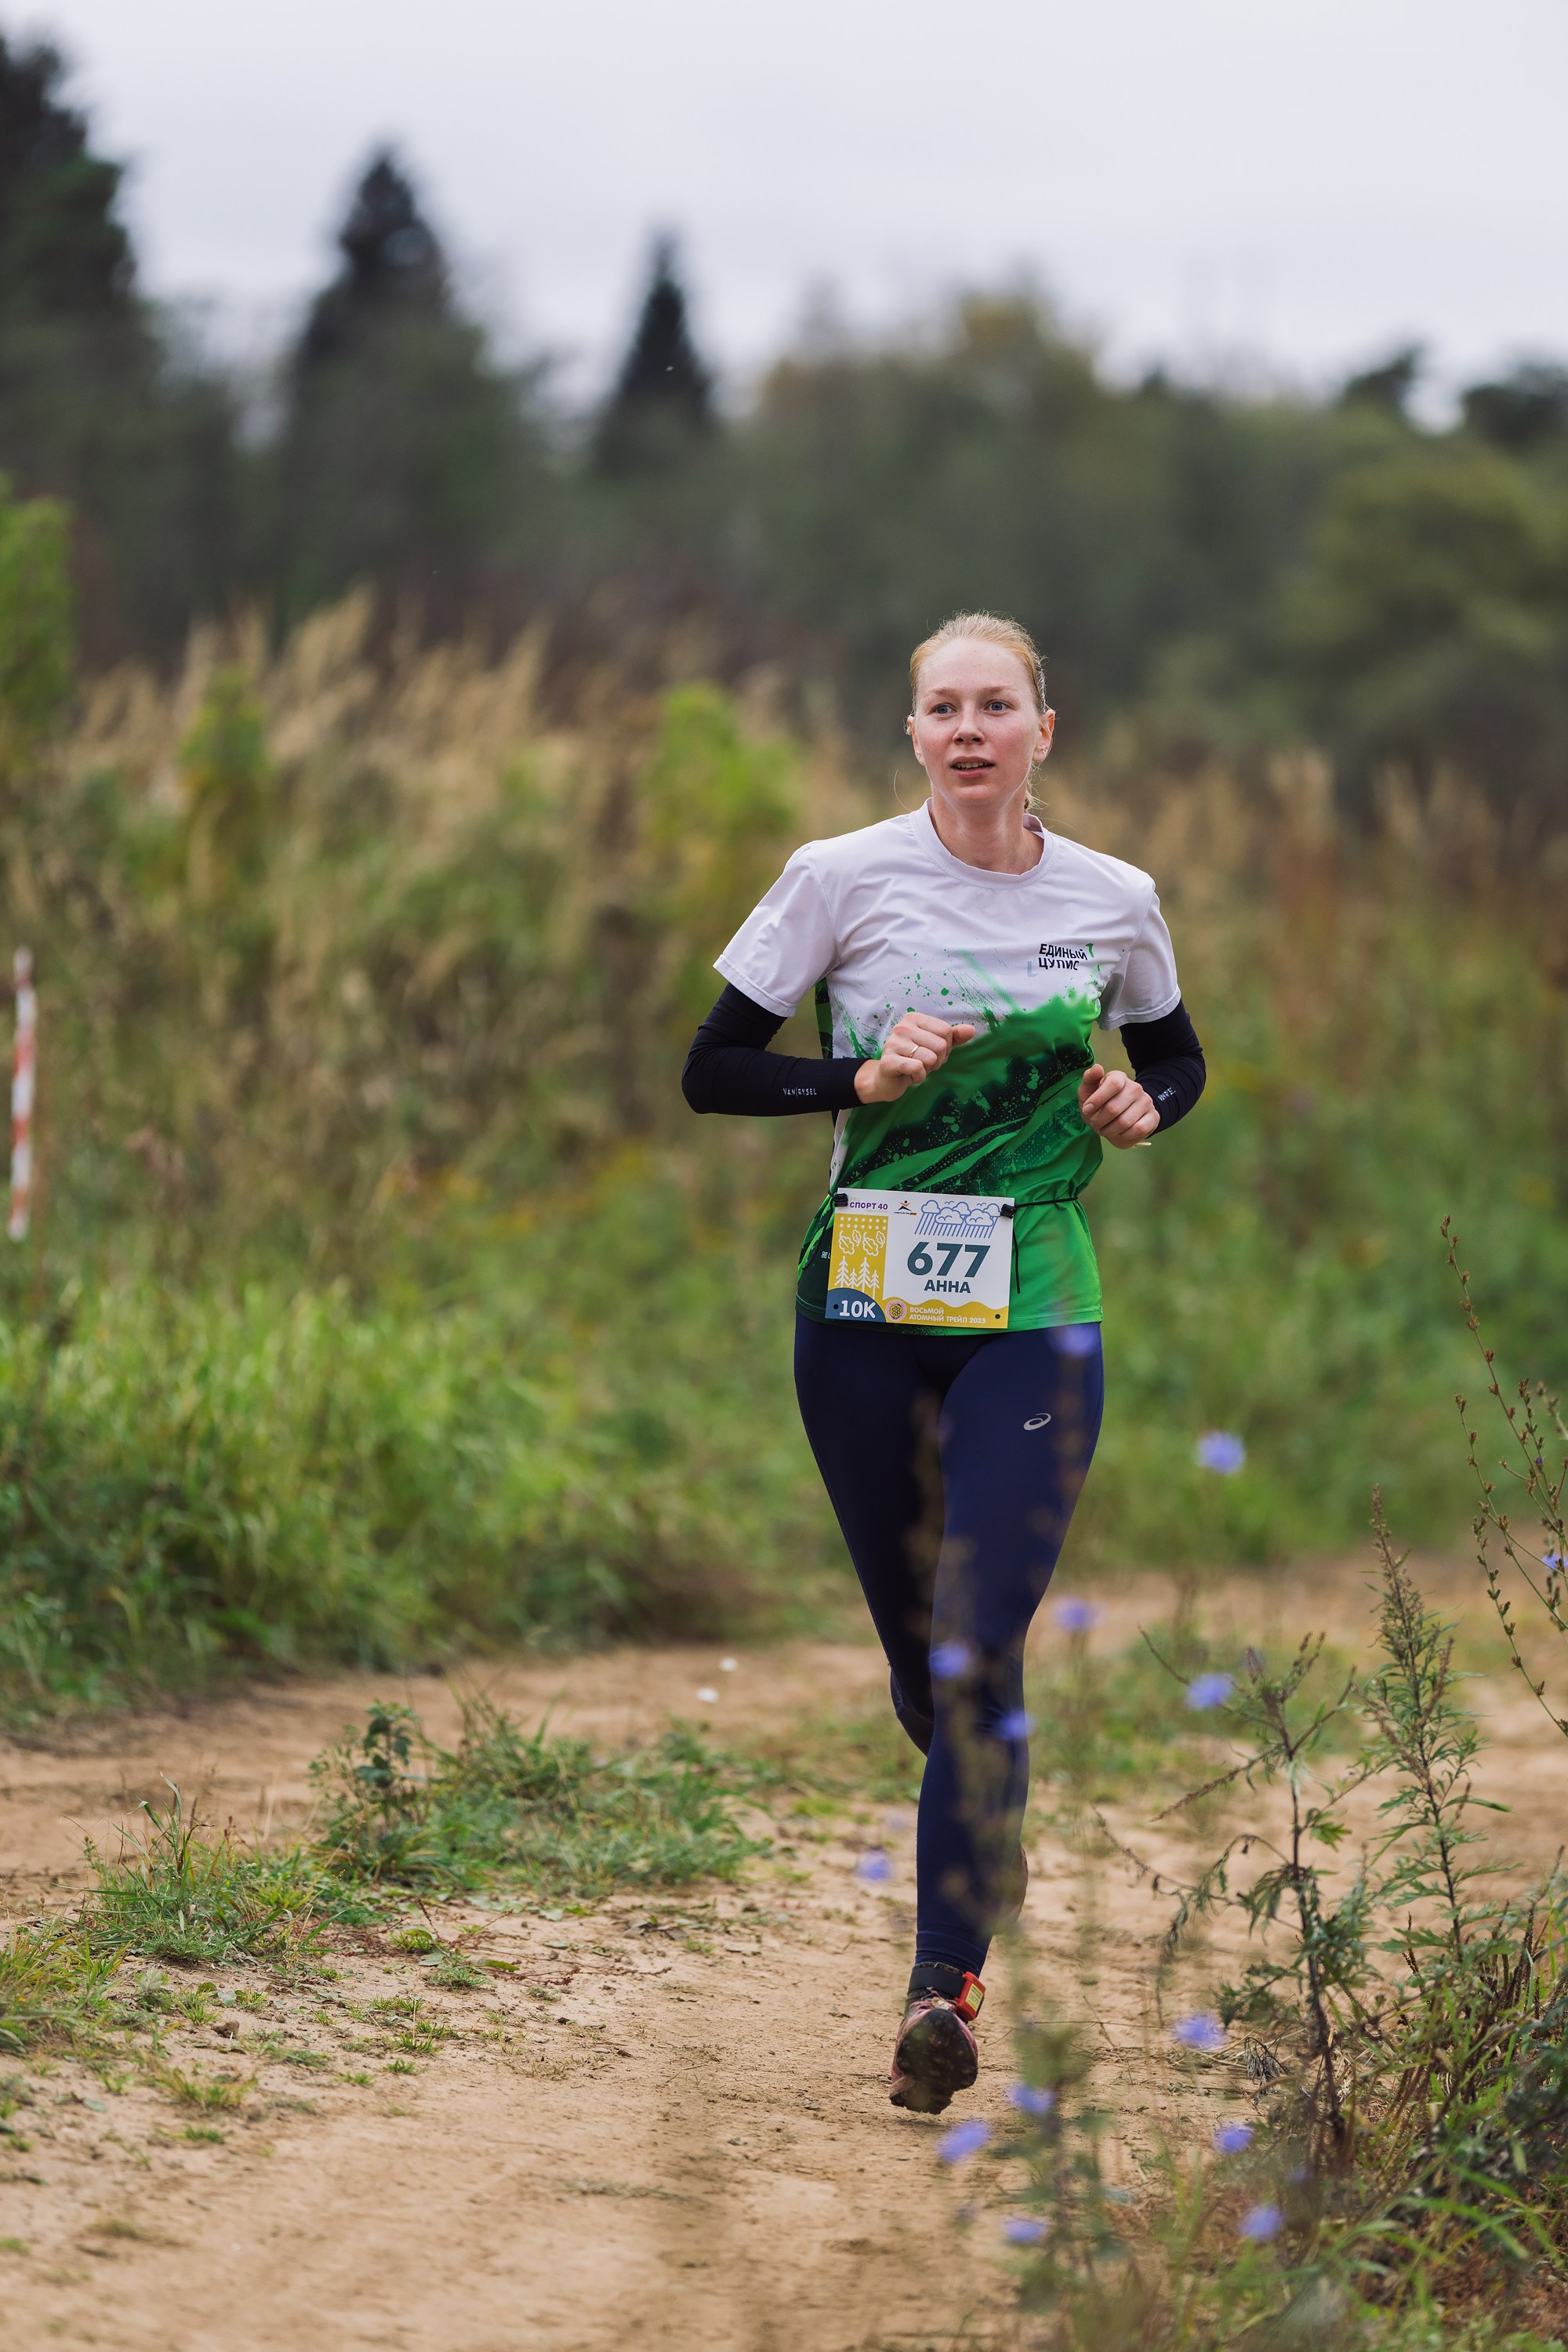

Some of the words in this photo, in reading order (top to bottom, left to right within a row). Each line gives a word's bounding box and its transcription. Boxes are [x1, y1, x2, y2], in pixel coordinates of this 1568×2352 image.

[1039, 943, 1087, 960] ЕДИНЫЙ
[1039, 957, 1080, 970] ЦУПИС
[907, 1241, 991, 1278] 677
[924, 1279, 971, 1294] АННА
[839, 1300, 877, 1319] 10K
